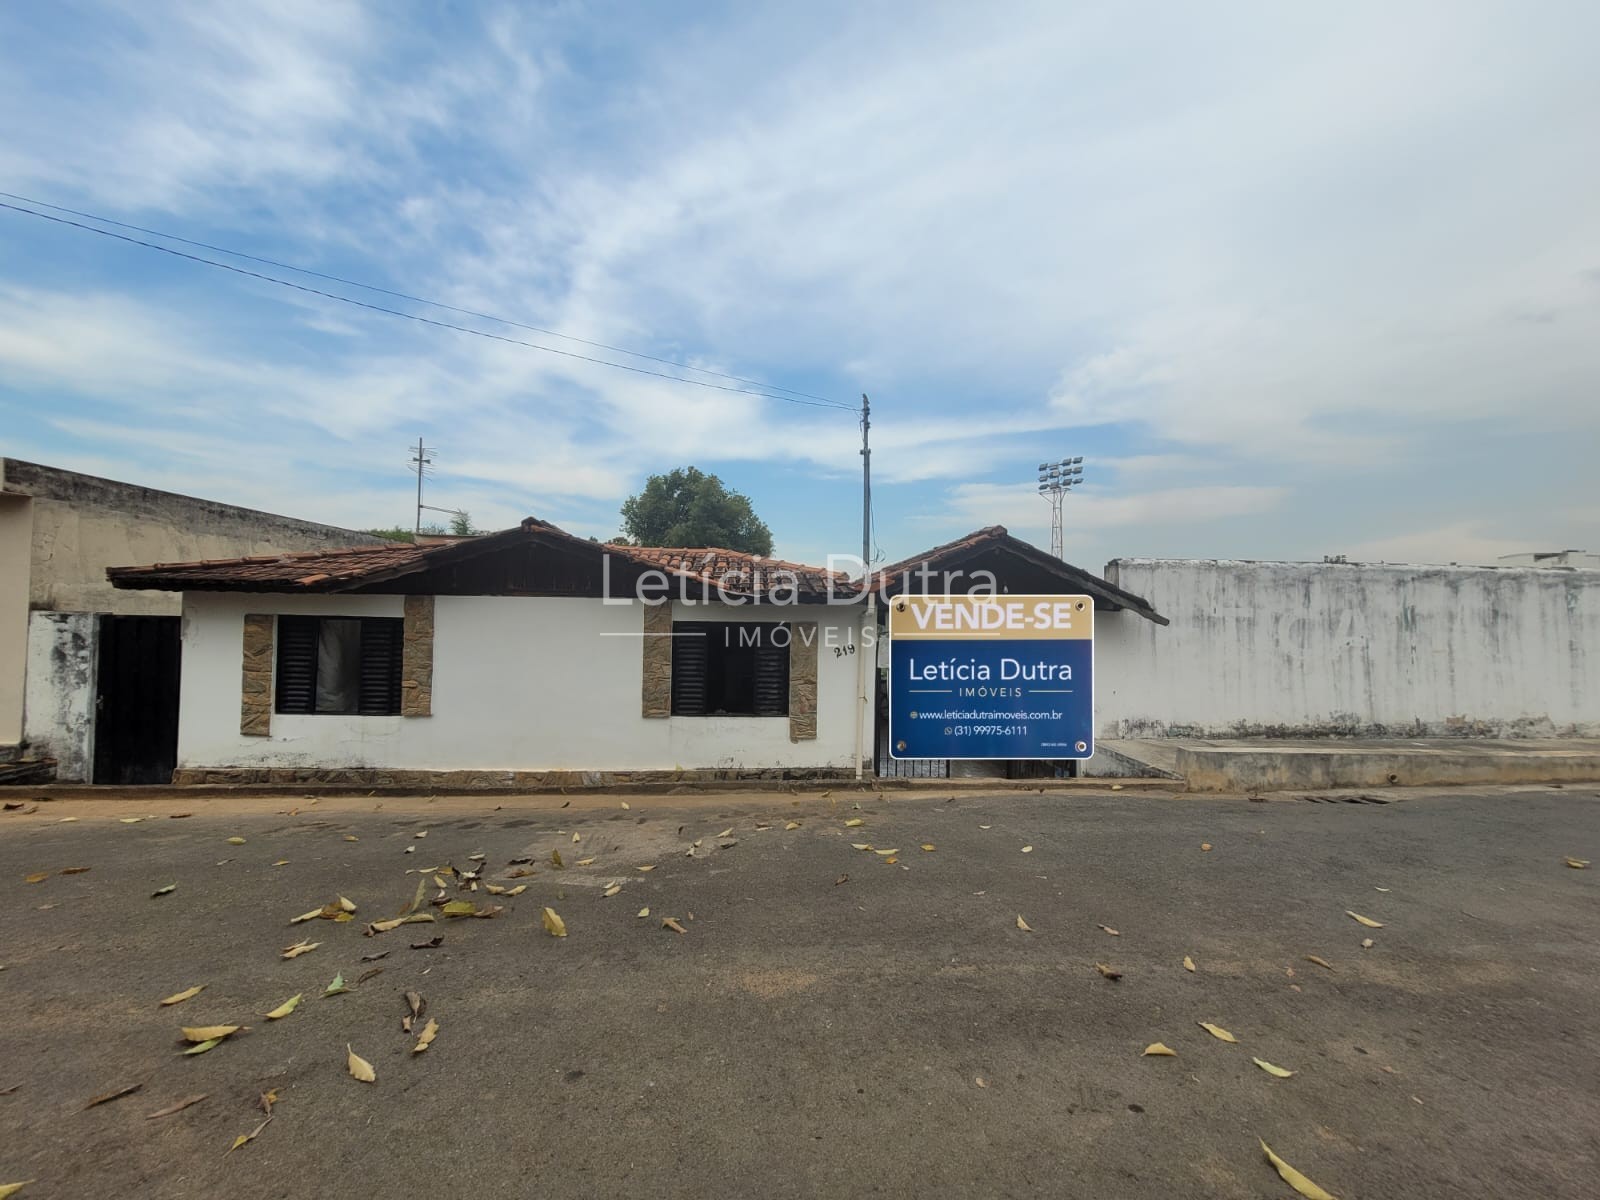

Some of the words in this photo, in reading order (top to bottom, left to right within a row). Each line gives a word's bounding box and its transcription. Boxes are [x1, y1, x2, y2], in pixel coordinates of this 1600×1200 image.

[911, 602, 1072, 630] VENDE-SE
[833, 643, 856, 659] 219
[909, 658, 990, 681] Letícia
[1000, 658, 1072, 681] Dutra
[959, 686, 1022, 697] IMÓVEIS
[919, 709, 1063, 720] www.leticiadutraimoveis.com.br
[954, 725, 972, 737] (31)
[973, 725, 1028, 737] 99975-6111
